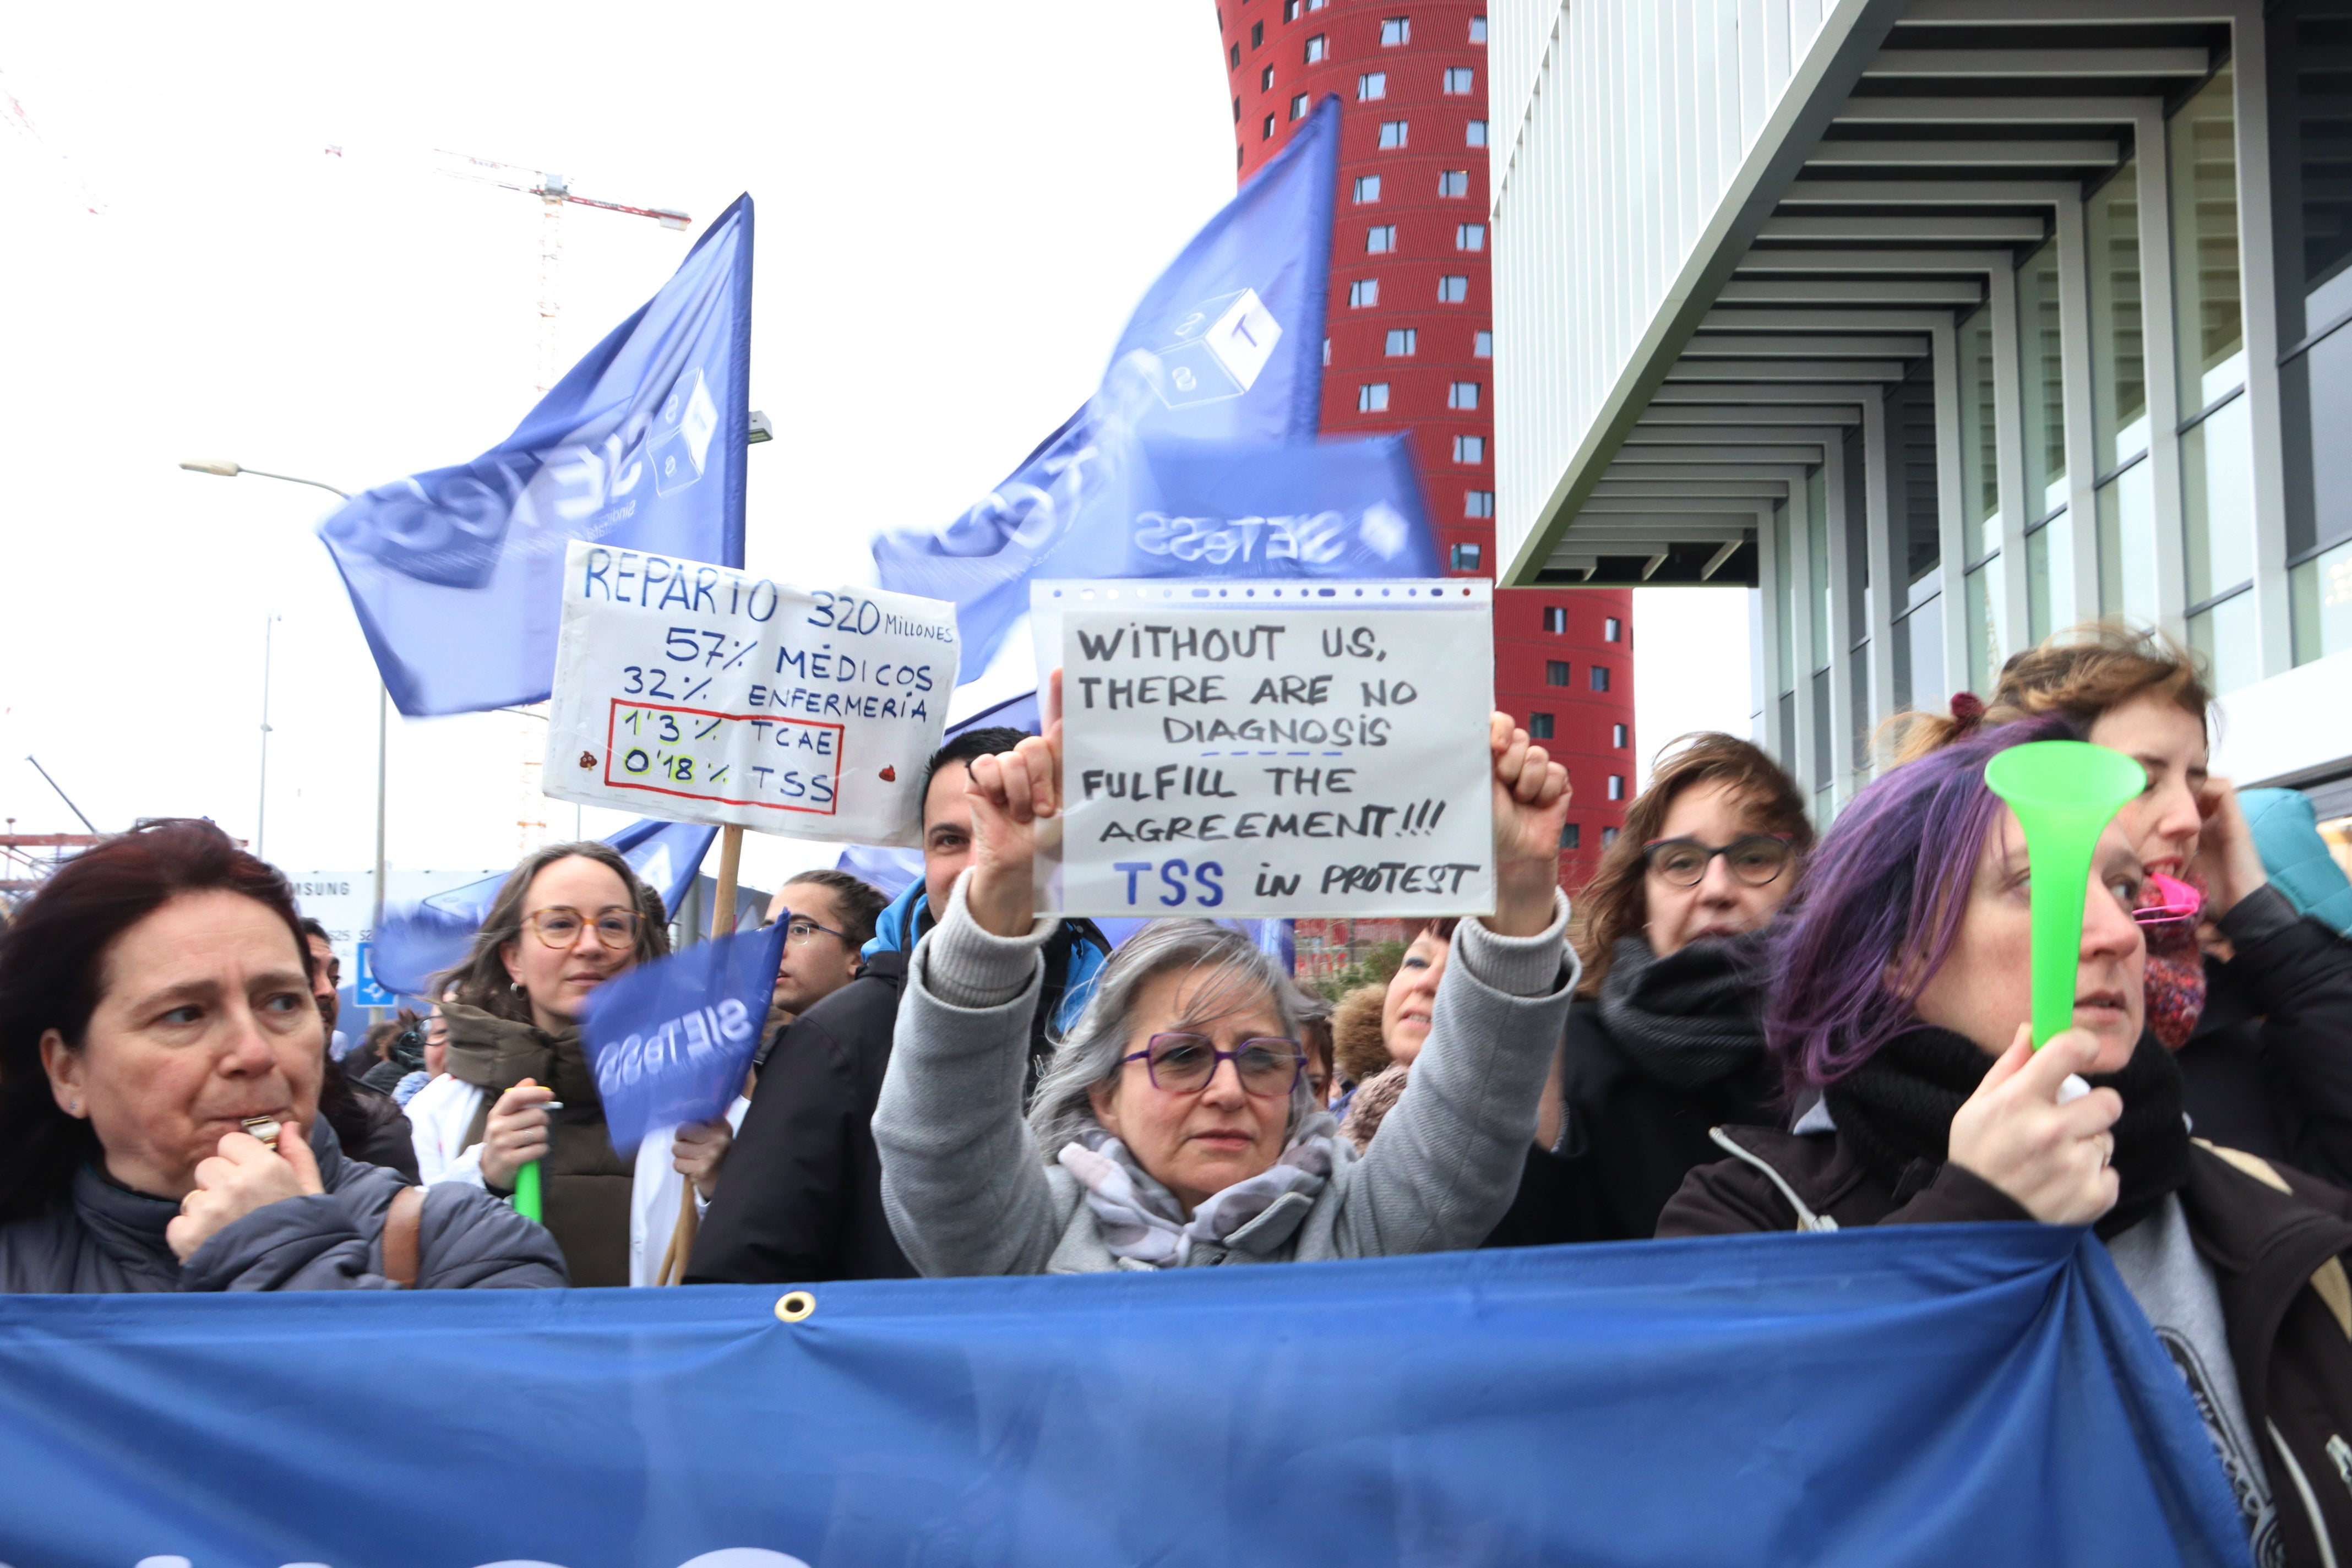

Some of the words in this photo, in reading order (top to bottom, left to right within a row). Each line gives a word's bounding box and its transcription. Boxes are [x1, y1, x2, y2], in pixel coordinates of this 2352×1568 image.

[585, 548, 778, 622] REPARTO
[807, 591, 880, 636] 320
[1322, 627, 1386, 662] US,
[775, 644, 933, 692] MÉDICOS
[1079, 676, 1227, 710] THERE
[1250, 674, 1333, 706] ARE
[1361, 679, 1417, 707] NO
[752, 720, 832, 755] TCAE
[752, 765, 834, 803] TSS
[1082, 764, 1237, 802] FULFILL
[1265, 767, 1355, 796] THE
[1100, 798, 1446, 842] AGREEMENT!!!
[1115, 858, 1224, 907] TSS
[1321, 863, 1480, 895] PROTEST
